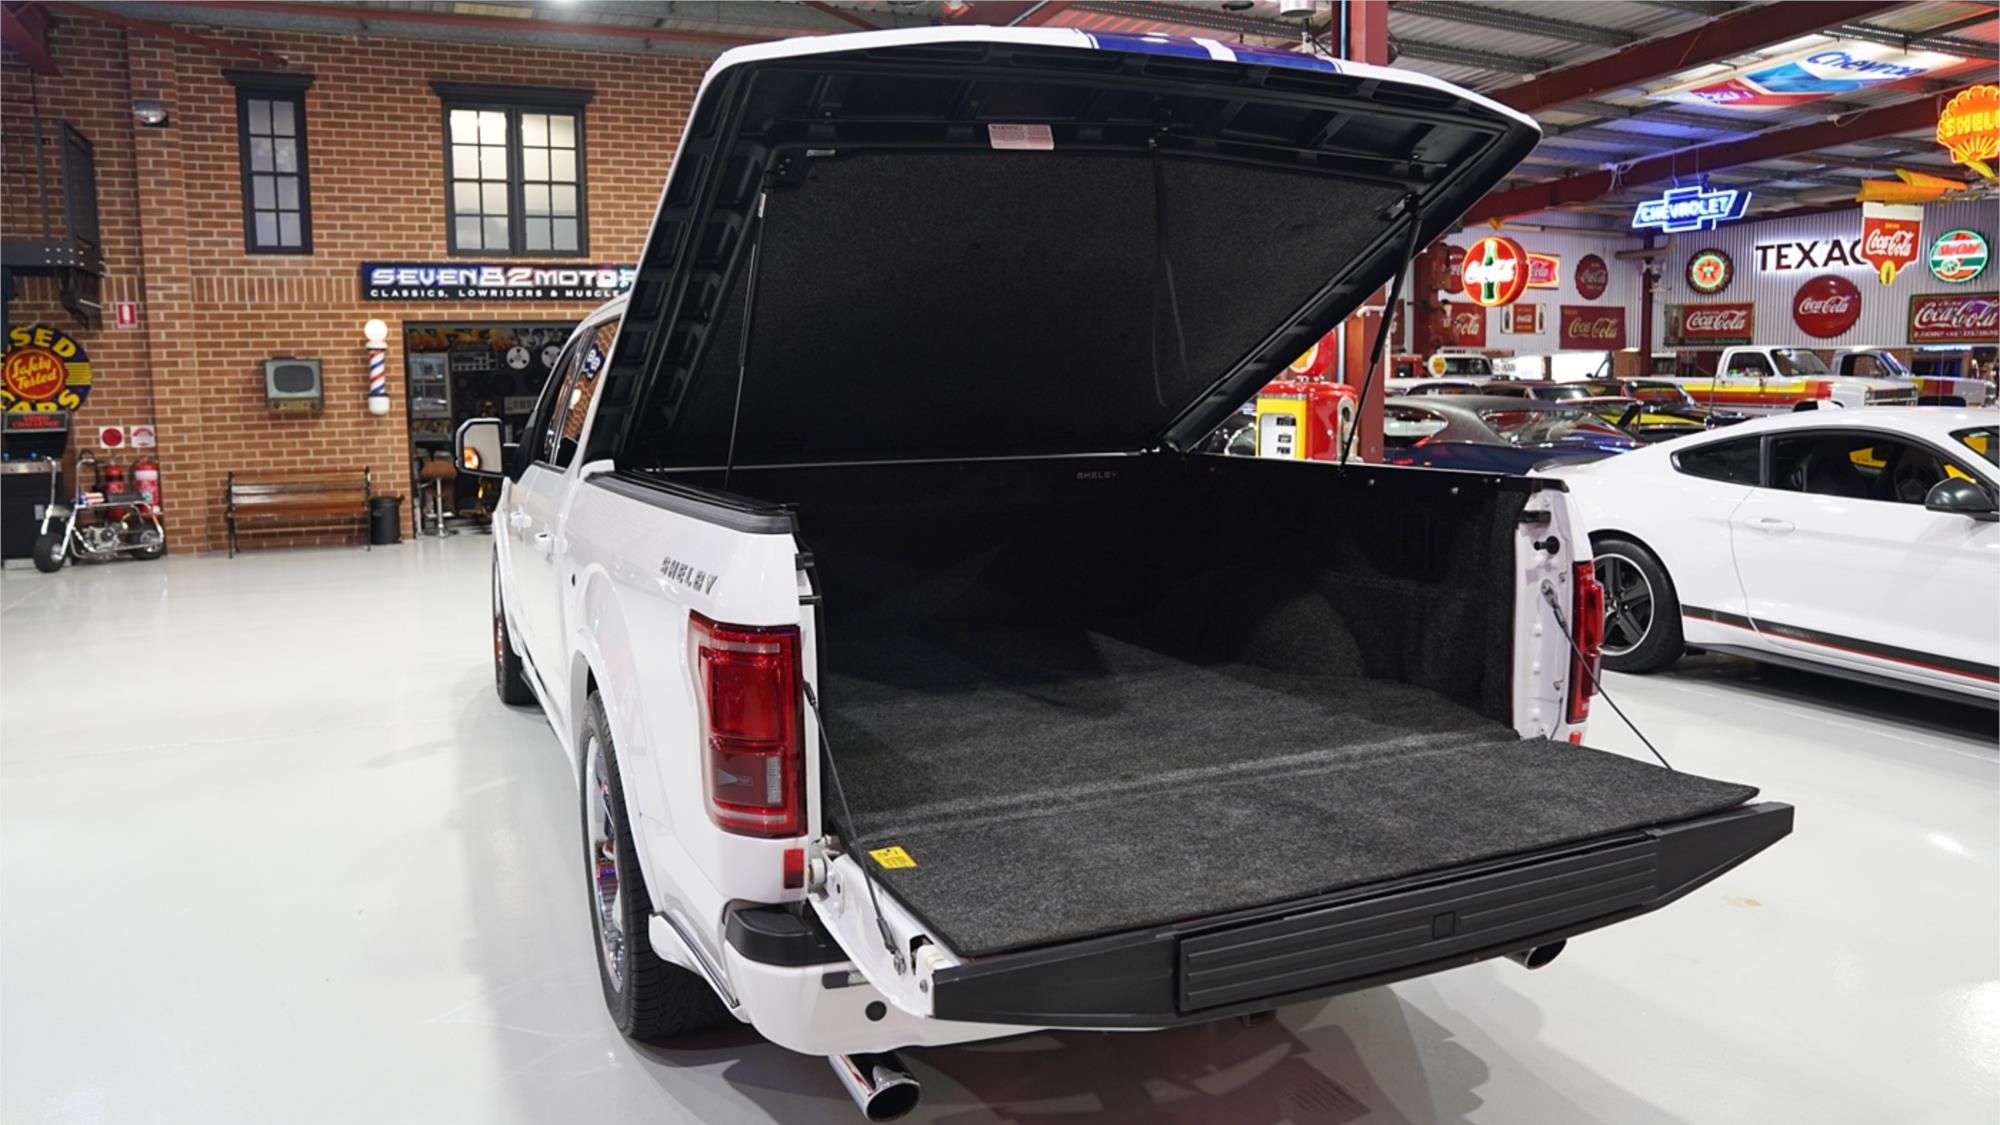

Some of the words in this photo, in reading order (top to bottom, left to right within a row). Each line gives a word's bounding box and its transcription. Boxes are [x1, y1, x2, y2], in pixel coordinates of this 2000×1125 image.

[1806, 51, 1930, 78] Chevron
[1640, 196, 1730, 222] CHEVROLET
[458, 289, 543, 298] LOWRIDERS
[565, 289, 620, 298] MUSCLE
[8, 326, 77, 359] SED
[12, 356, 52, 379] Safety
[16, 367, 57, 390] Tested
[660, 556, 718, 595] SHELBY
